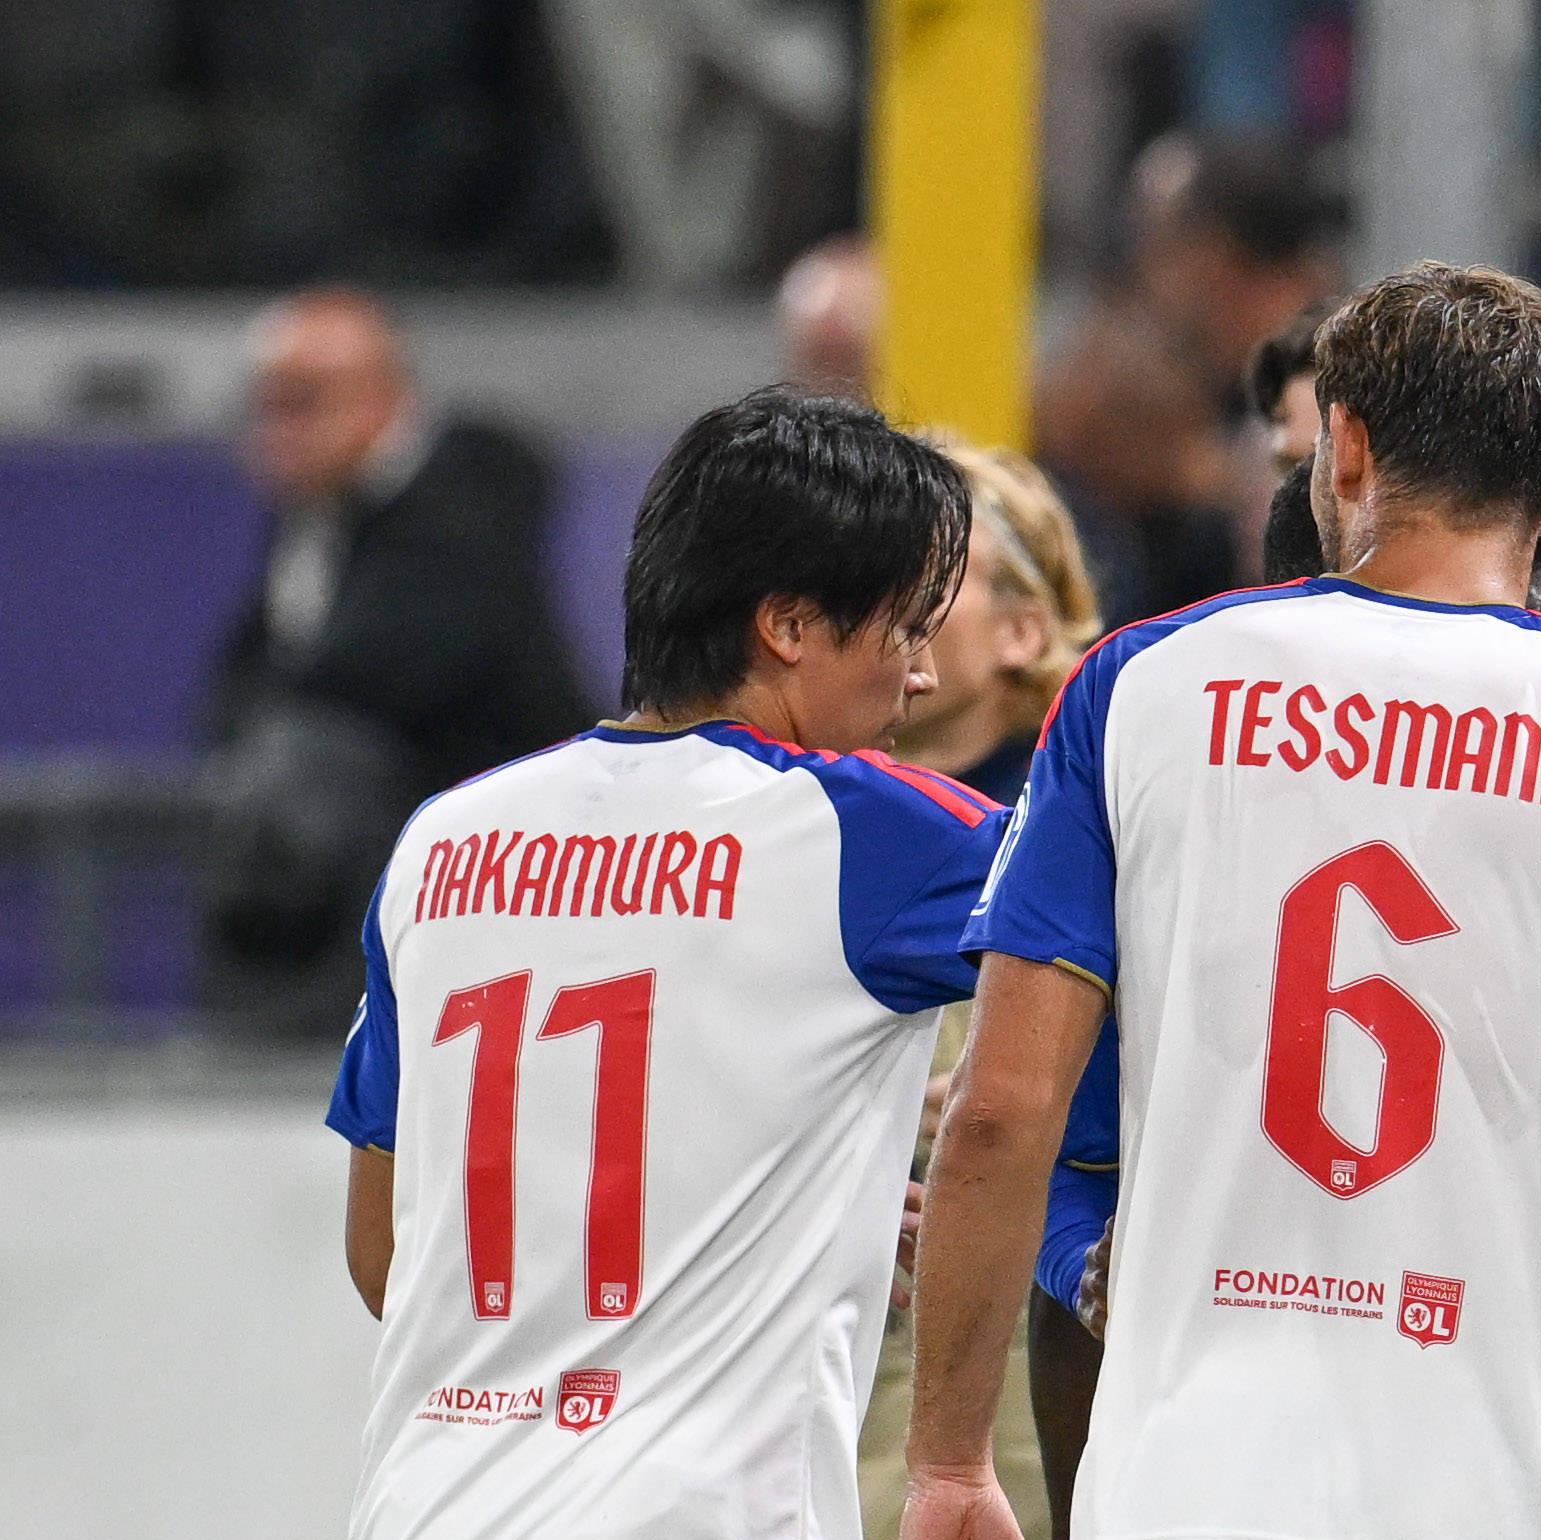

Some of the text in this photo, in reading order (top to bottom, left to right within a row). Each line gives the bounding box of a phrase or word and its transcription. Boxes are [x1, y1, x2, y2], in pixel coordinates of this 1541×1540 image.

[415, 829, 743, 923] NAKAMURA
[1261, 839, 1461, 1200] 6
[431, 969, 656, 1321] 11
[1333, 1172, 1353, 1186] OL
[1214, 1269, 1384, 1305] FONDATION
[1406, 1285, 1457, 1302] LYONNAIS
[1407, 1278, 1459, 1292] OLYMPIQUE
[603, 1295, 623, 1307] OL
[1213, 1297, 1383, 1320] SOLIDAIRE SUR TOUS LES TERRAINS
[1404, 1303, 1449, 1336] OL
[427, 1386, 544, 1413] NDATIN
[564, 1382, 614, 1392] LYONNAIS
[446, 1411, 464, 1424] SUR
[467, 1416, 489, 1426] TOUS
[563, 1395, 607, 1424] OL
